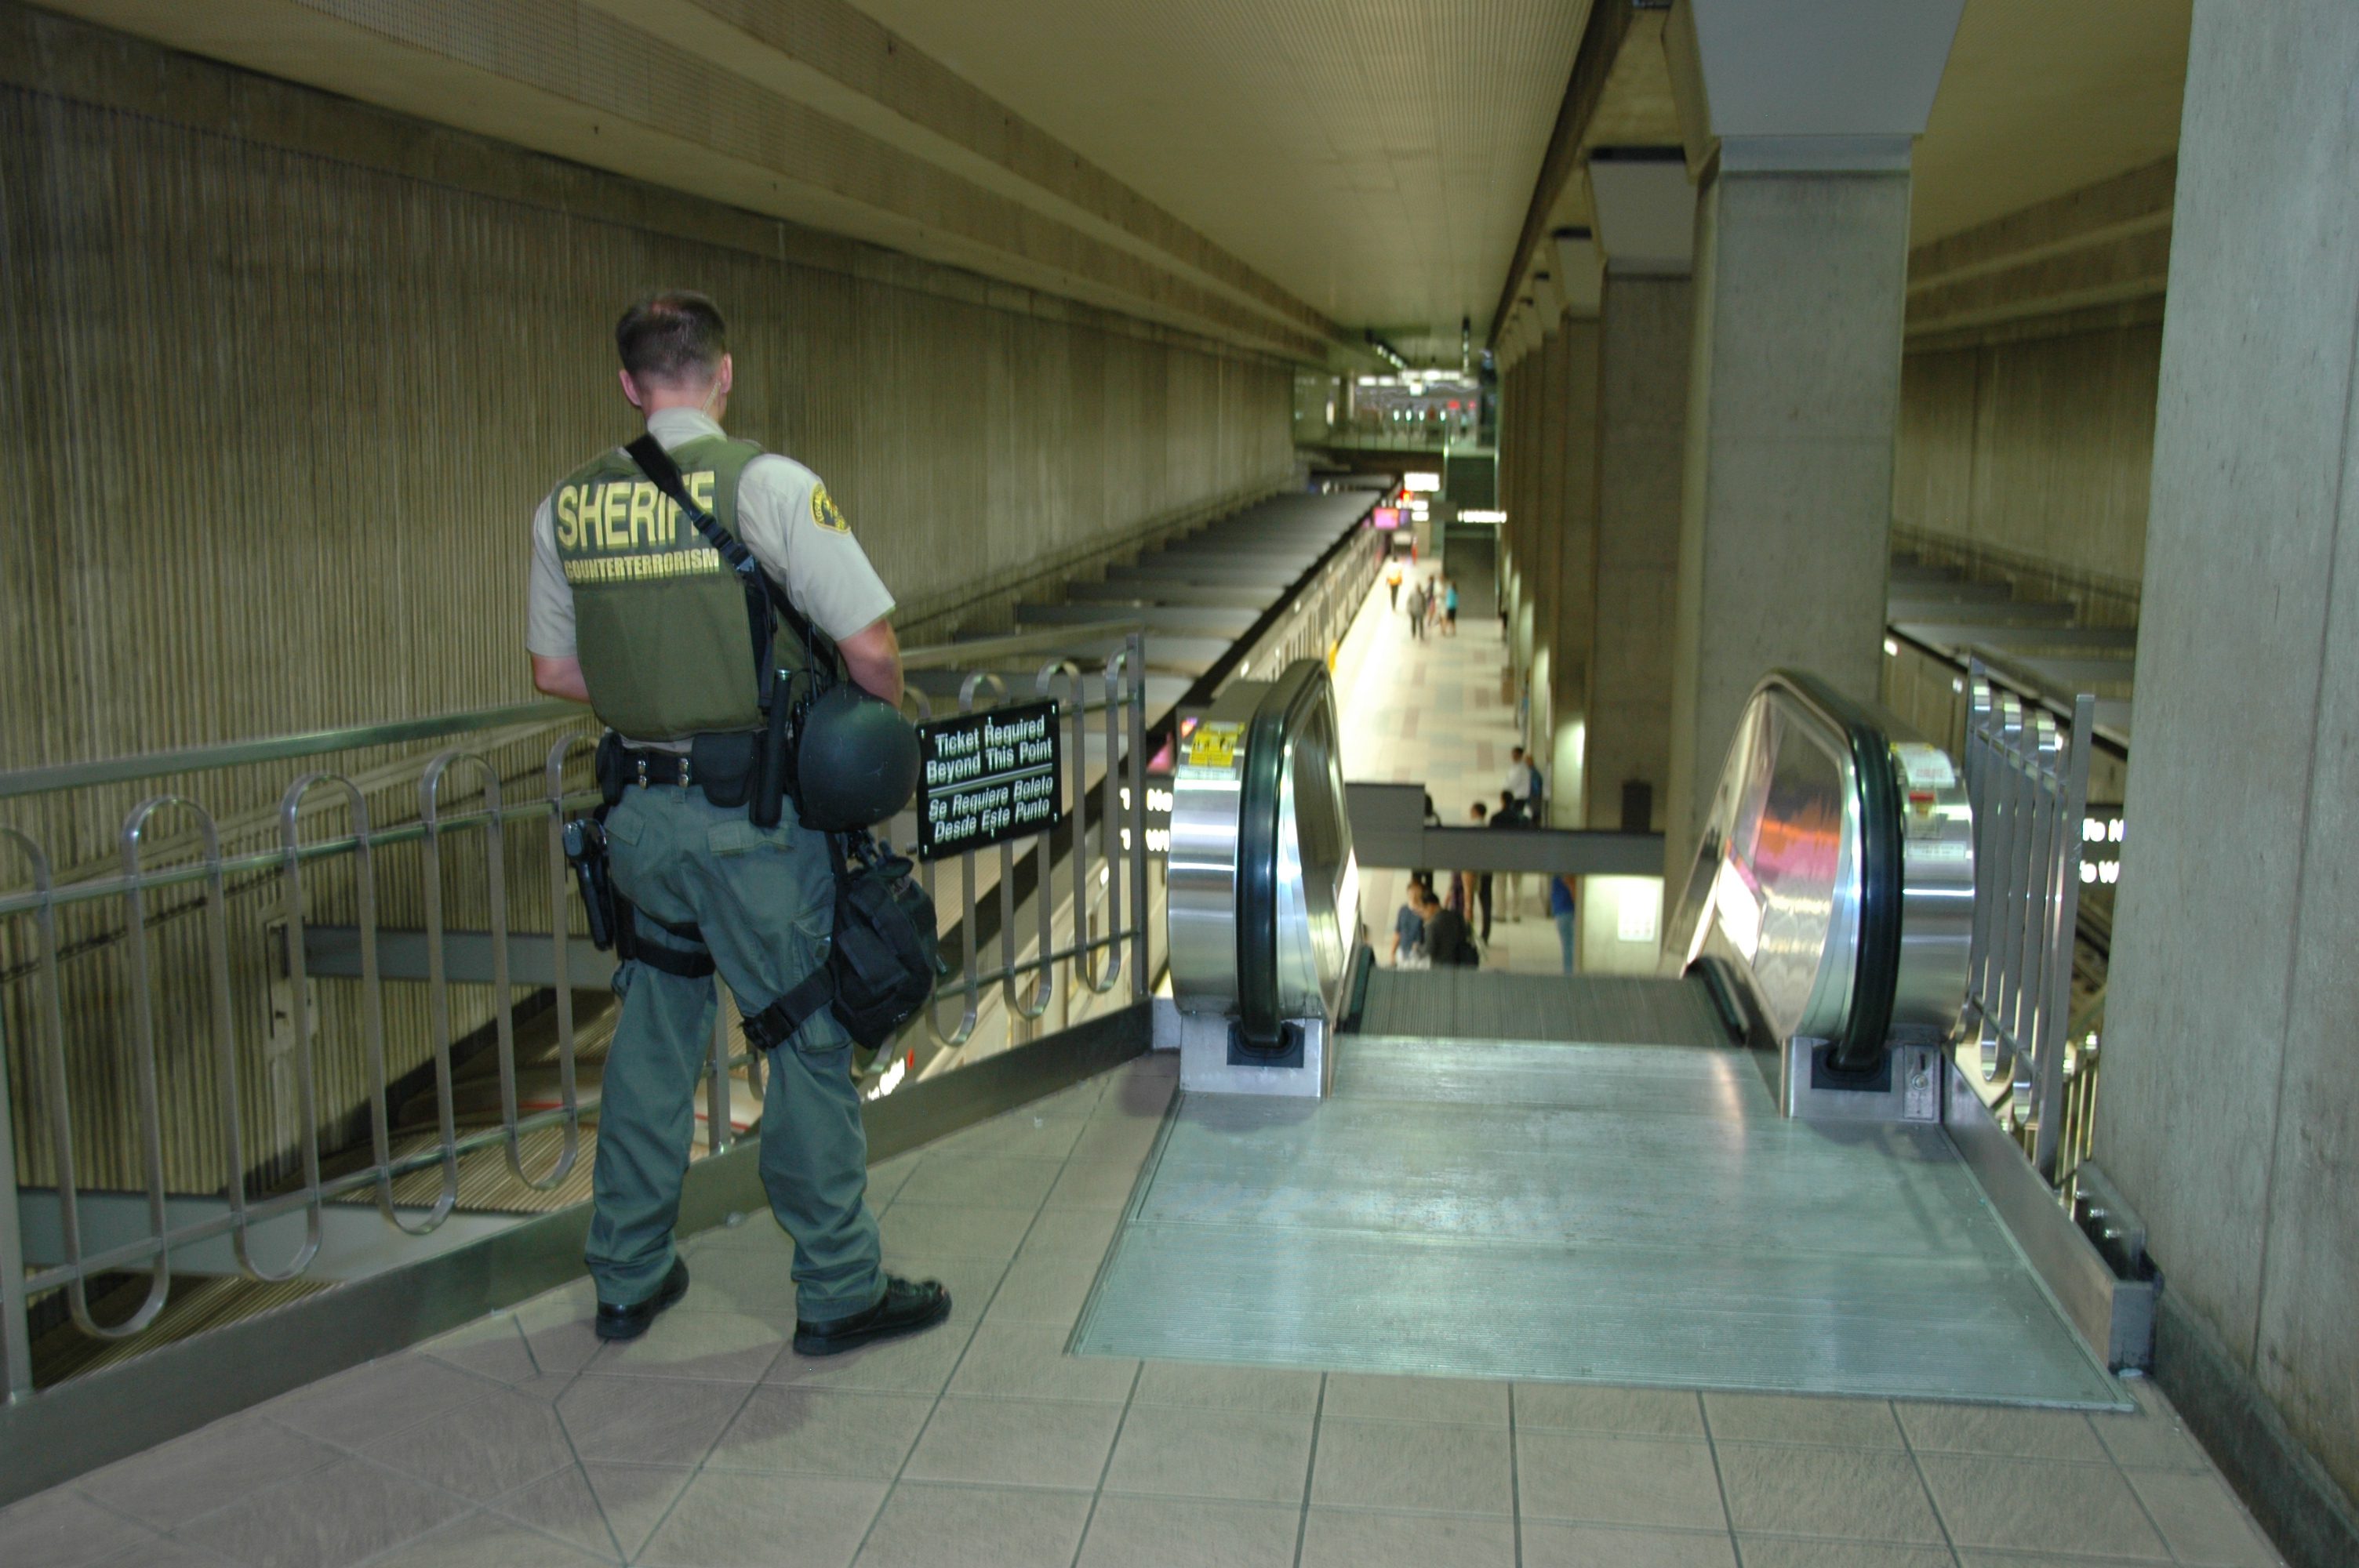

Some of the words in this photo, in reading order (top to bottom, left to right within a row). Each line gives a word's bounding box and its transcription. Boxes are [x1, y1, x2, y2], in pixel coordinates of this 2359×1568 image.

[558, 470, 715, 550] SHERIFF
[565, 548, 719, 583] COUNTERTERRORISM
[936, 728, 979, 757] Ticket
[984, 714, 1045, 748] Required
[927, 750, 980, 784] Beyond
[986, 746, 1014, 772] This
[1020, 737, 1052, 765] Point
[929, 798, 947, 822] Se
[953, 786, 1009, 816] Requiere
[1013, 775, 1053, 803] Boleto
[934, 814, 977, 844] Desde
[981, 807, 1010, 833] Este
[1015, 797, 1050, 823] Punto
